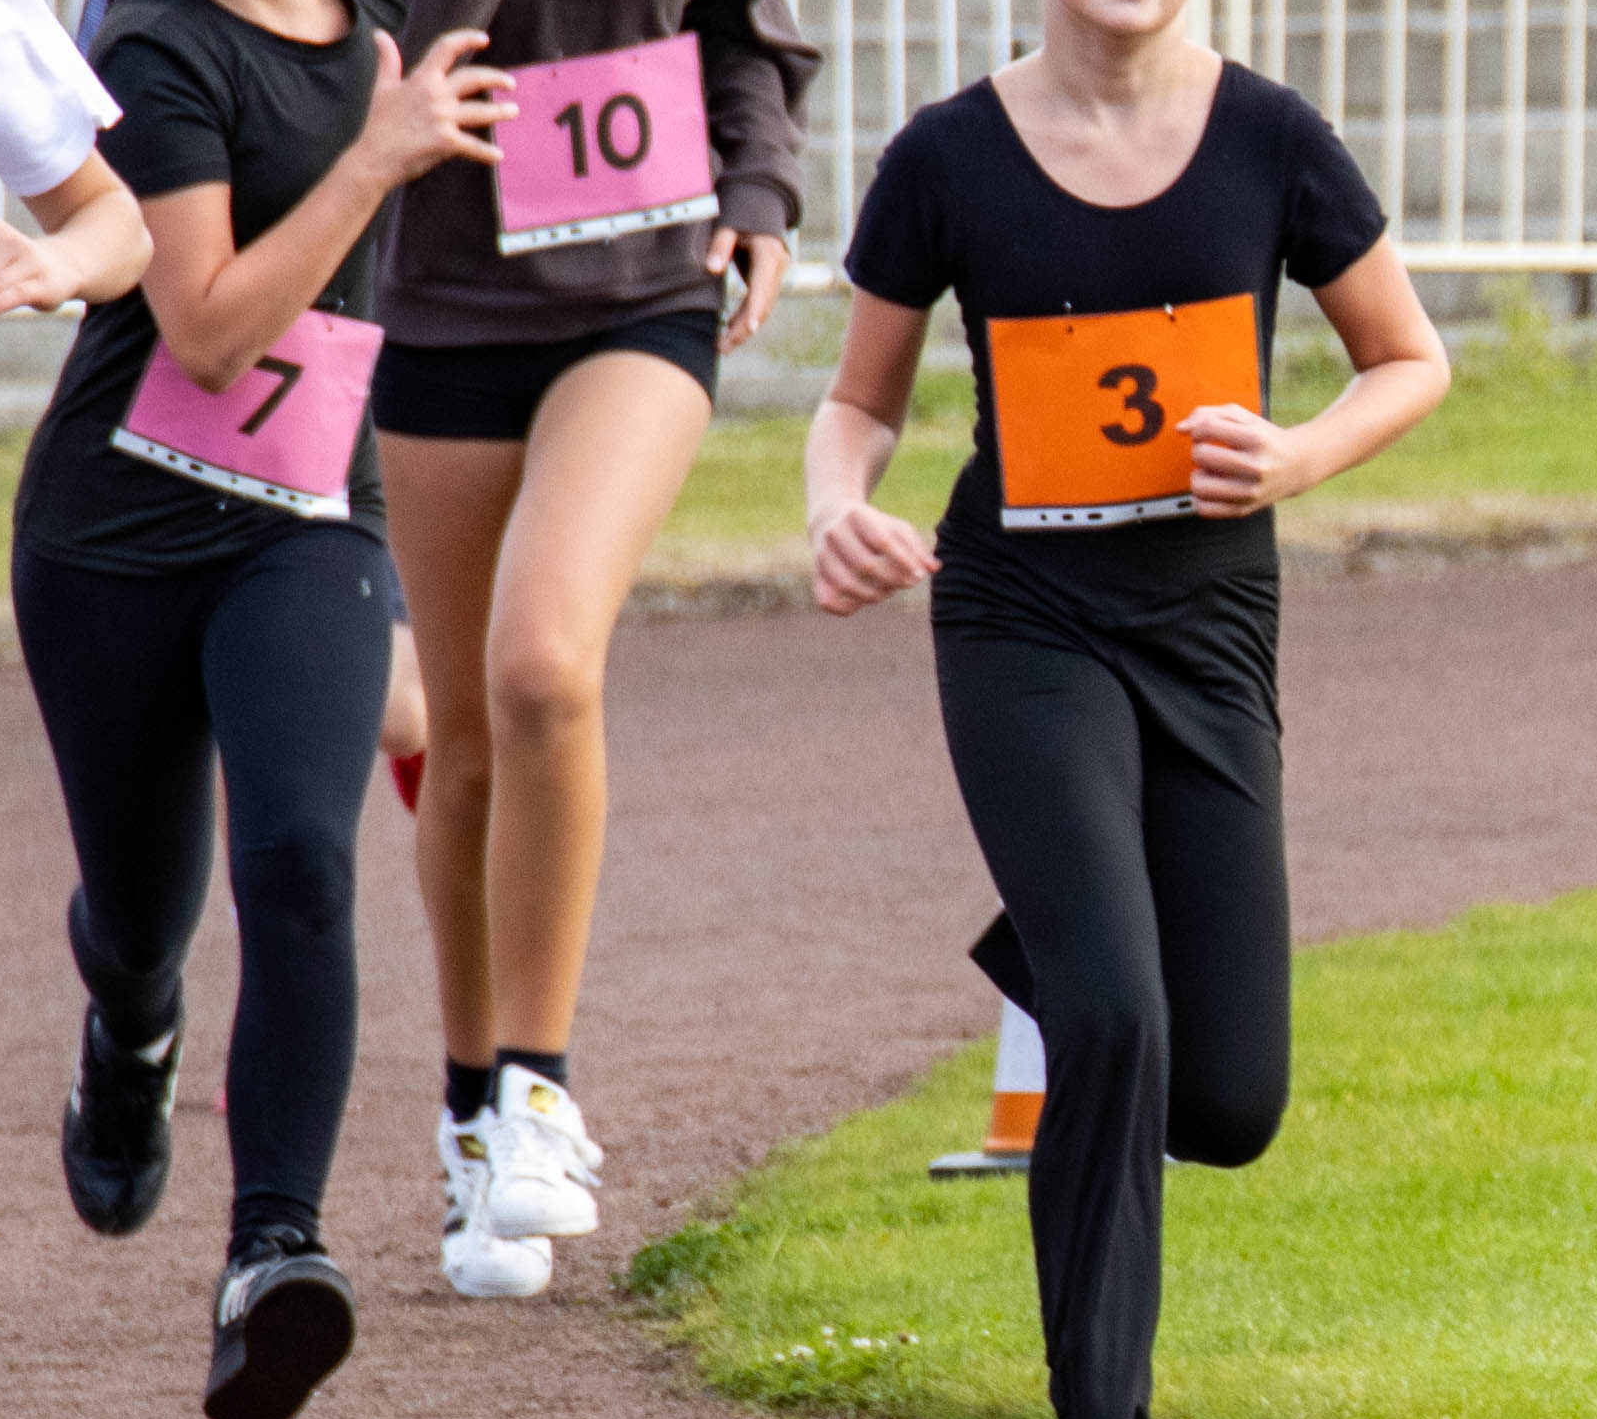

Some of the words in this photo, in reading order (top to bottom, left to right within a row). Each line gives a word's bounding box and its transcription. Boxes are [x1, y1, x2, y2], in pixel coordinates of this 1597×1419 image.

[555, 94, 652, 179] 10
[236, 355, 305, 436] 7
[1098, 365, 1166, 446] 3
